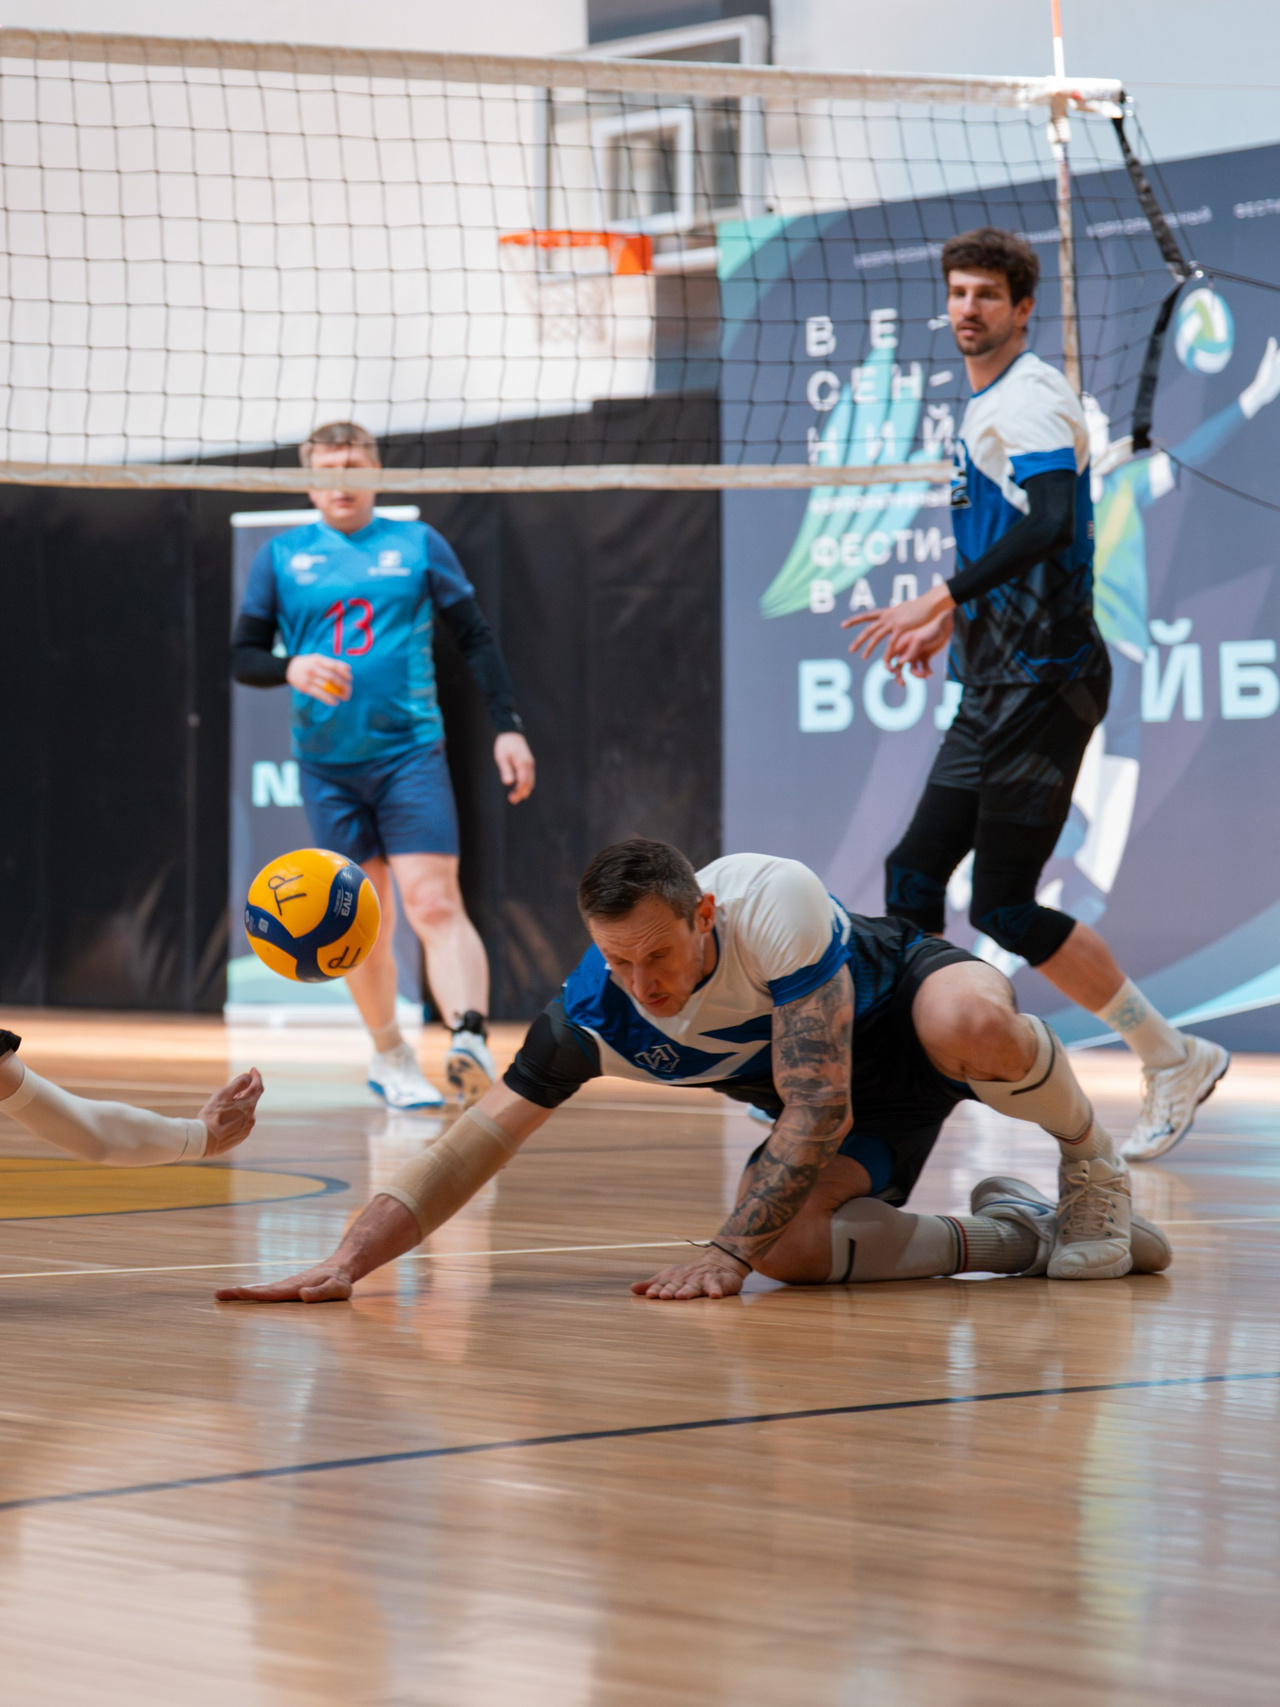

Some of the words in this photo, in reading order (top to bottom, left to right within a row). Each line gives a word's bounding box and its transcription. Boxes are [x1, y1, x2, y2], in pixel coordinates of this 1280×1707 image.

[810, 526, 956, 567] ФЕСТИ-
[809, 572, 943, 614] ВАЛ
[323, 597, 375, 656] 13
[341, 891, 354, 918] FIVB
